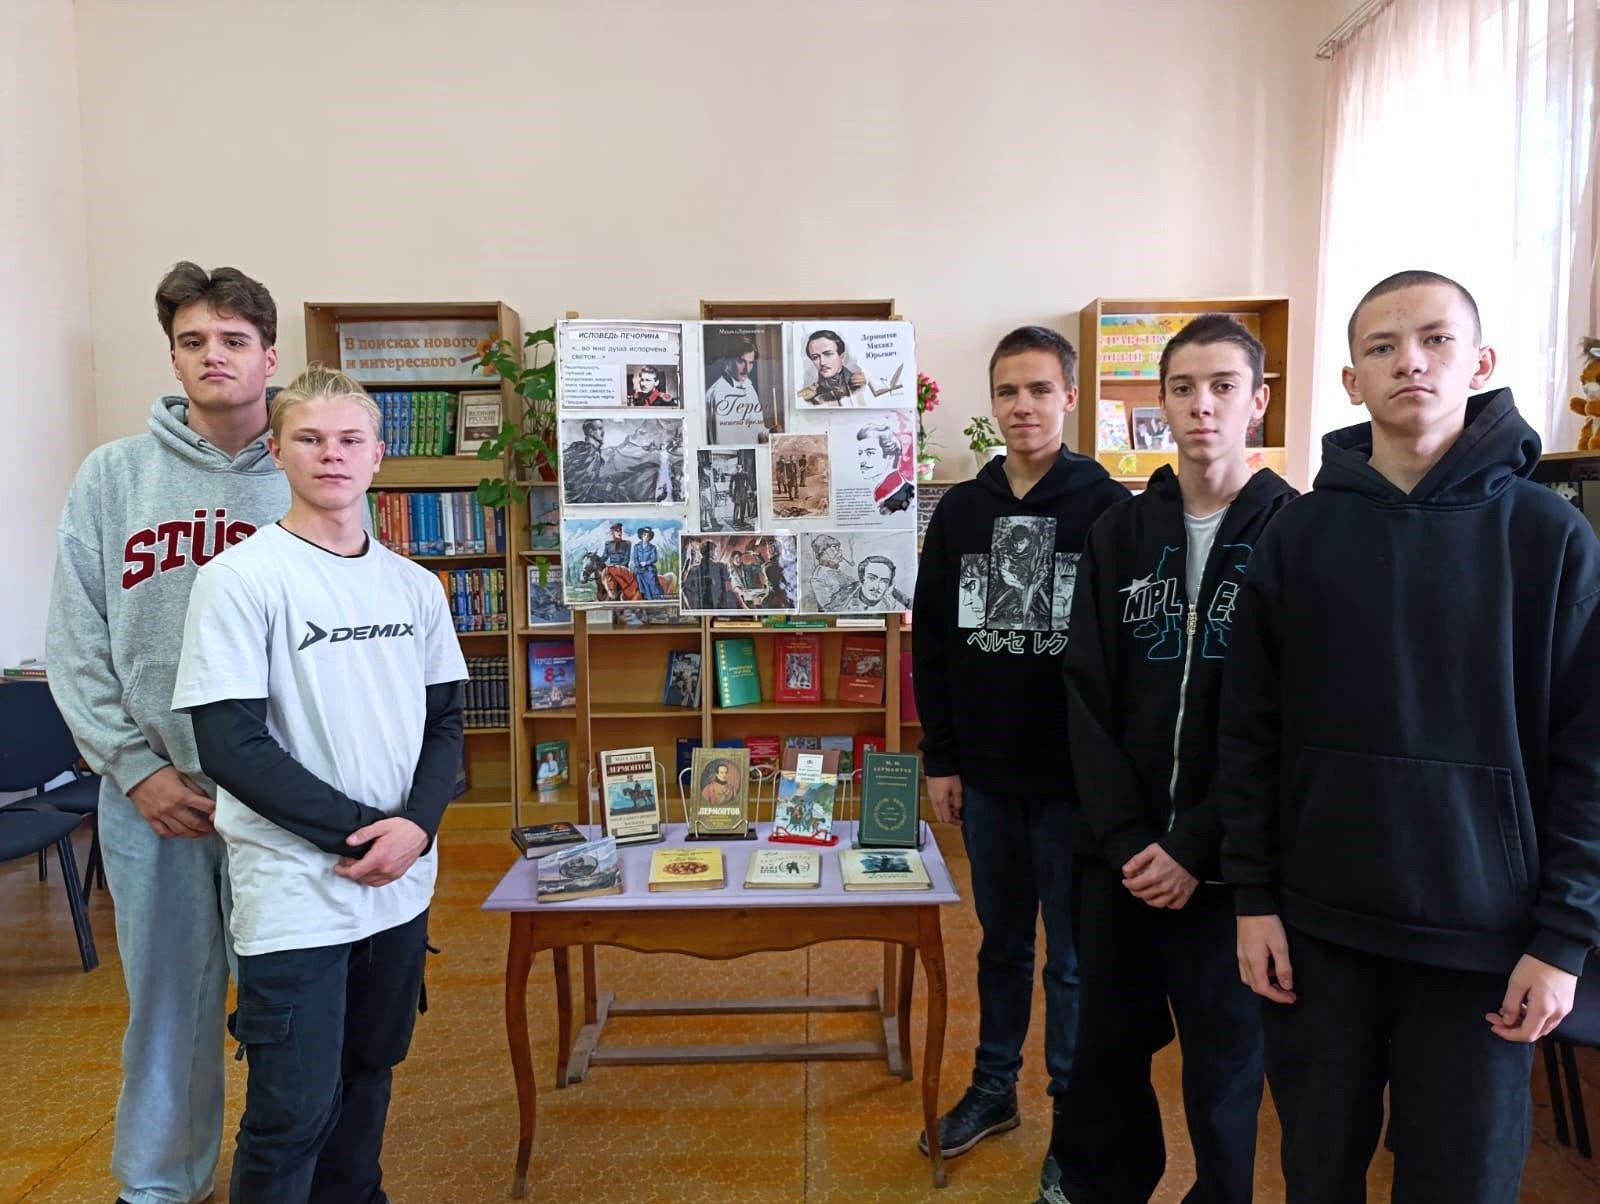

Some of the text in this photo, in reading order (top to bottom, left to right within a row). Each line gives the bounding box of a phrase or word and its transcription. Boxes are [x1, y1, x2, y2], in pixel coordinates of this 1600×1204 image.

[344, 336, 478, 350] В поисках нового
[346, 357, 456, 370] и интересного
[330, 623, 414, 642] DEMIX
[608, 763, 651, 773] ЛЕРМОНТОВ
[697, 807, 740, 815] ЛЕРМОНТОВ
